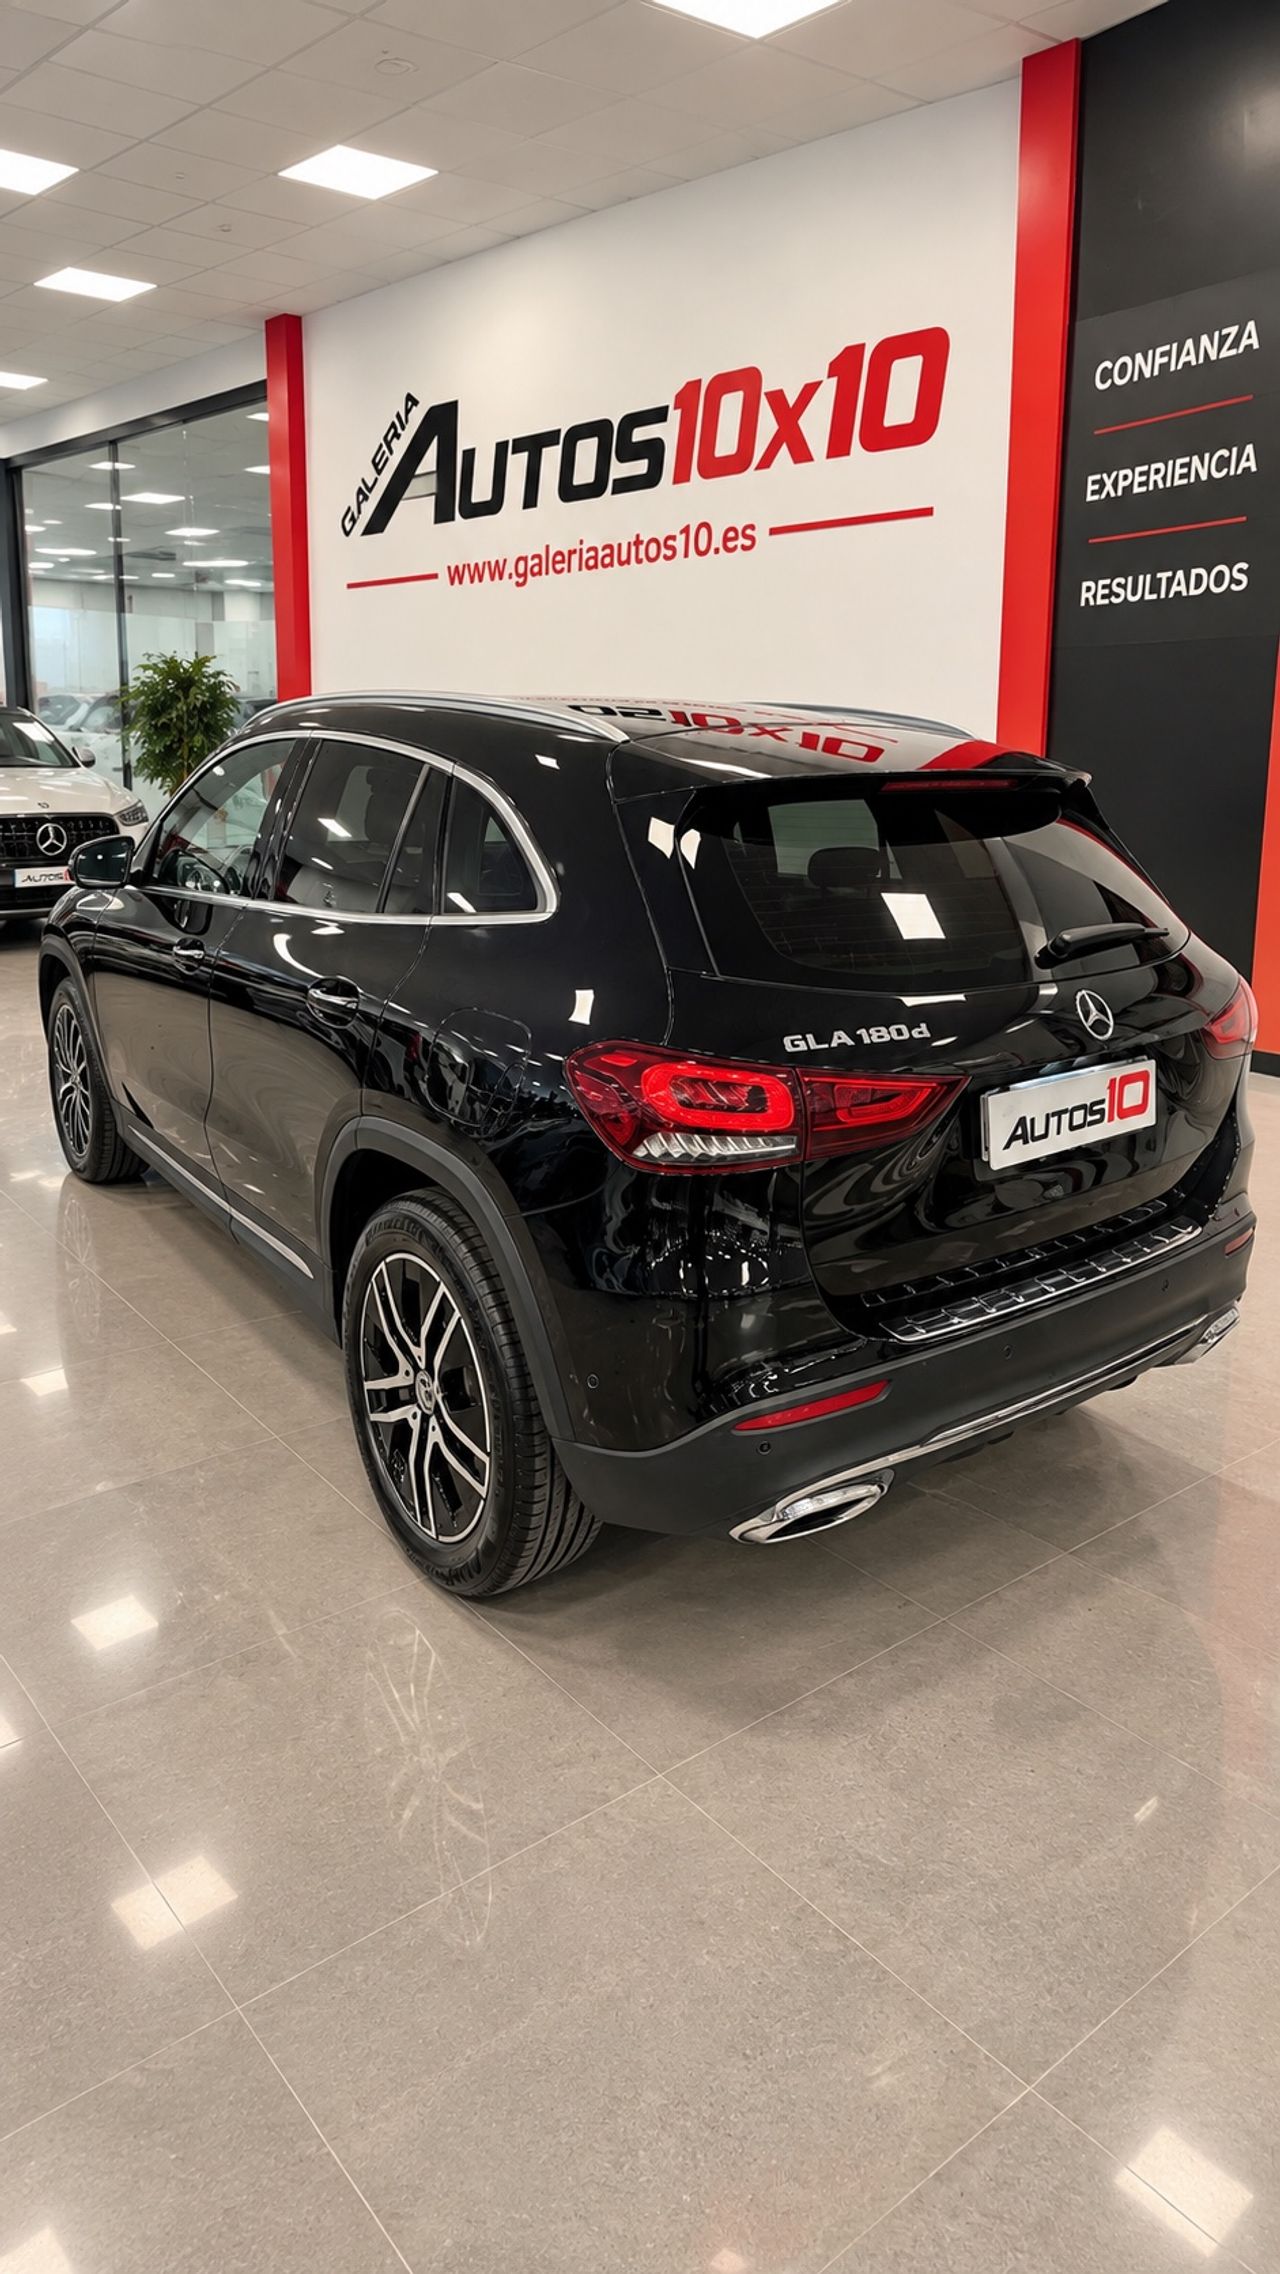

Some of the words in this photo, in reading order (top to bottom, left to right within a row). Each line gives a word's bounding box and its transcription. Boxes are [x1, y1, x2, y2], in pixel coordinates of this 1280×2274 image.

[1094, 319, 1260, 391] CONFIANZA
[340, 391, 420, 538] GALERIA
[1085, 443, 1258, 502] EXPERIENCIA
[446, 521, 757, 588] www.galeriaautos10.es
[1079, 561, 1250, 607] RESULTADOS
[783, 1033, 855, 1054] GLA
[856, 1022, 931, 1044] 180d
[1002, 1069, 1151, 1151] AUTOS10
